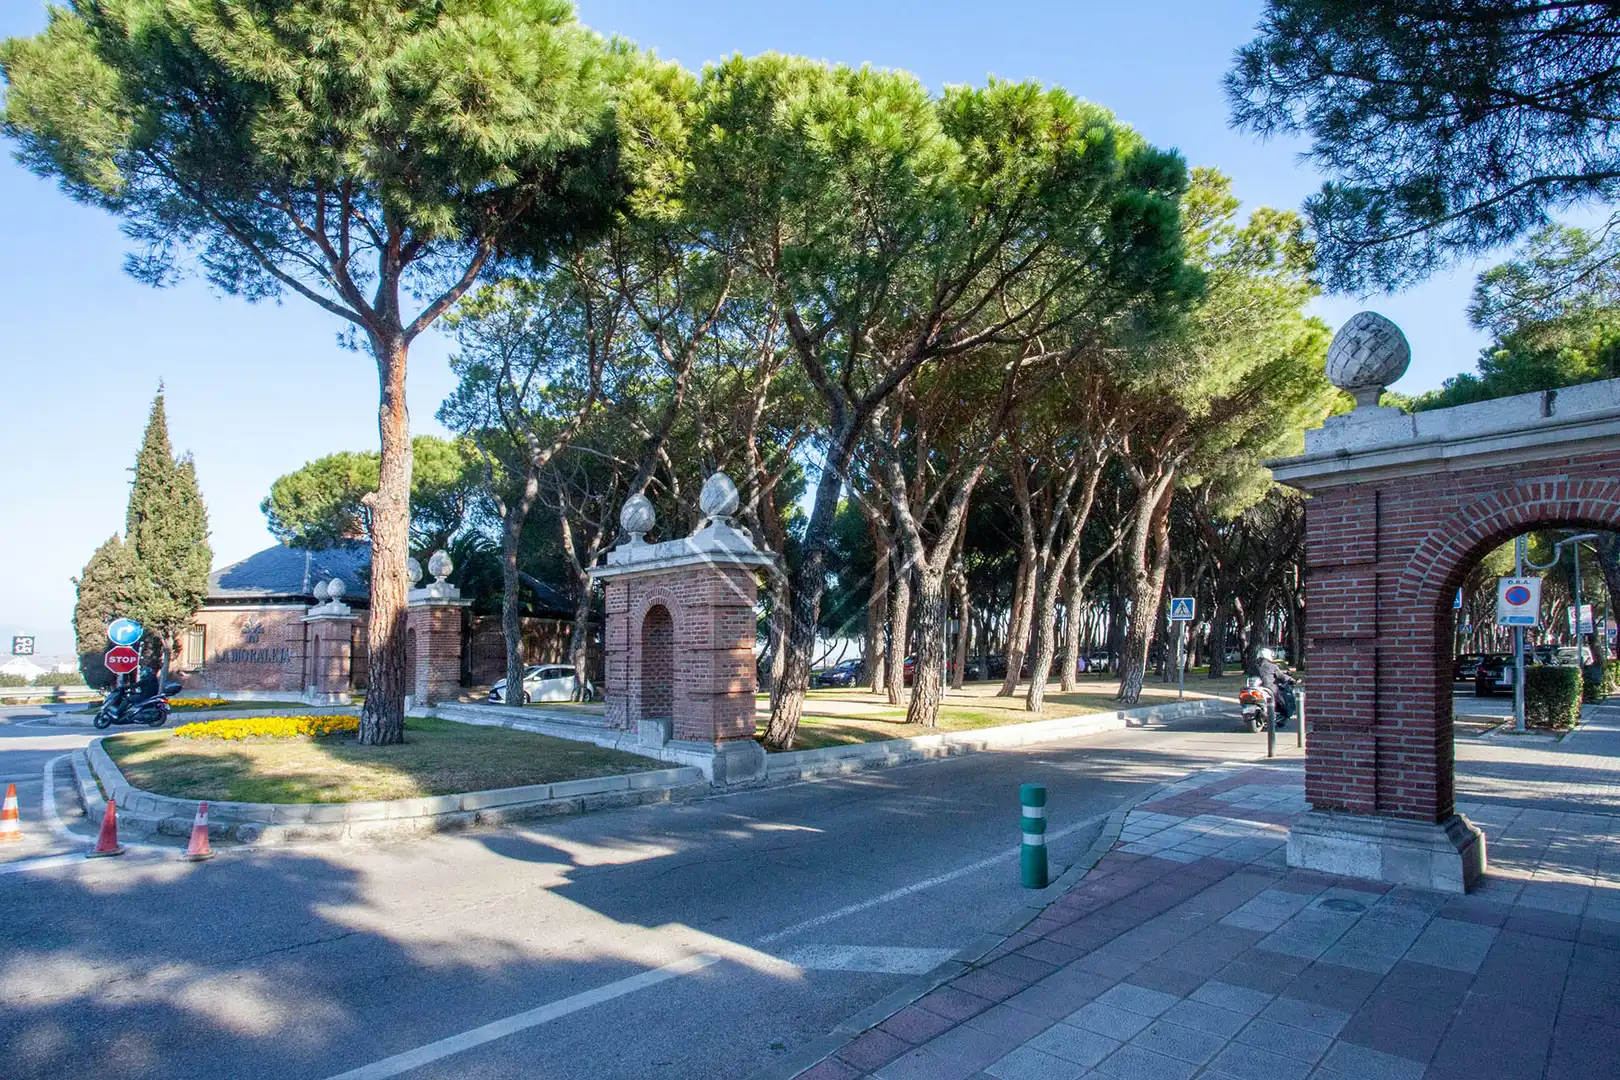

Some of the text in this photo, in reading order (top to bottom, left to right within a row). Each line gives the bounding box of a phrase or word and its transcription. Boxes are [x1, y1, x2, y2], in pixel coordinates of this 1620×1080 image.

[109, 656, 137, 664] STOP
[214, 647, 290, 664] LA MORALEJA
